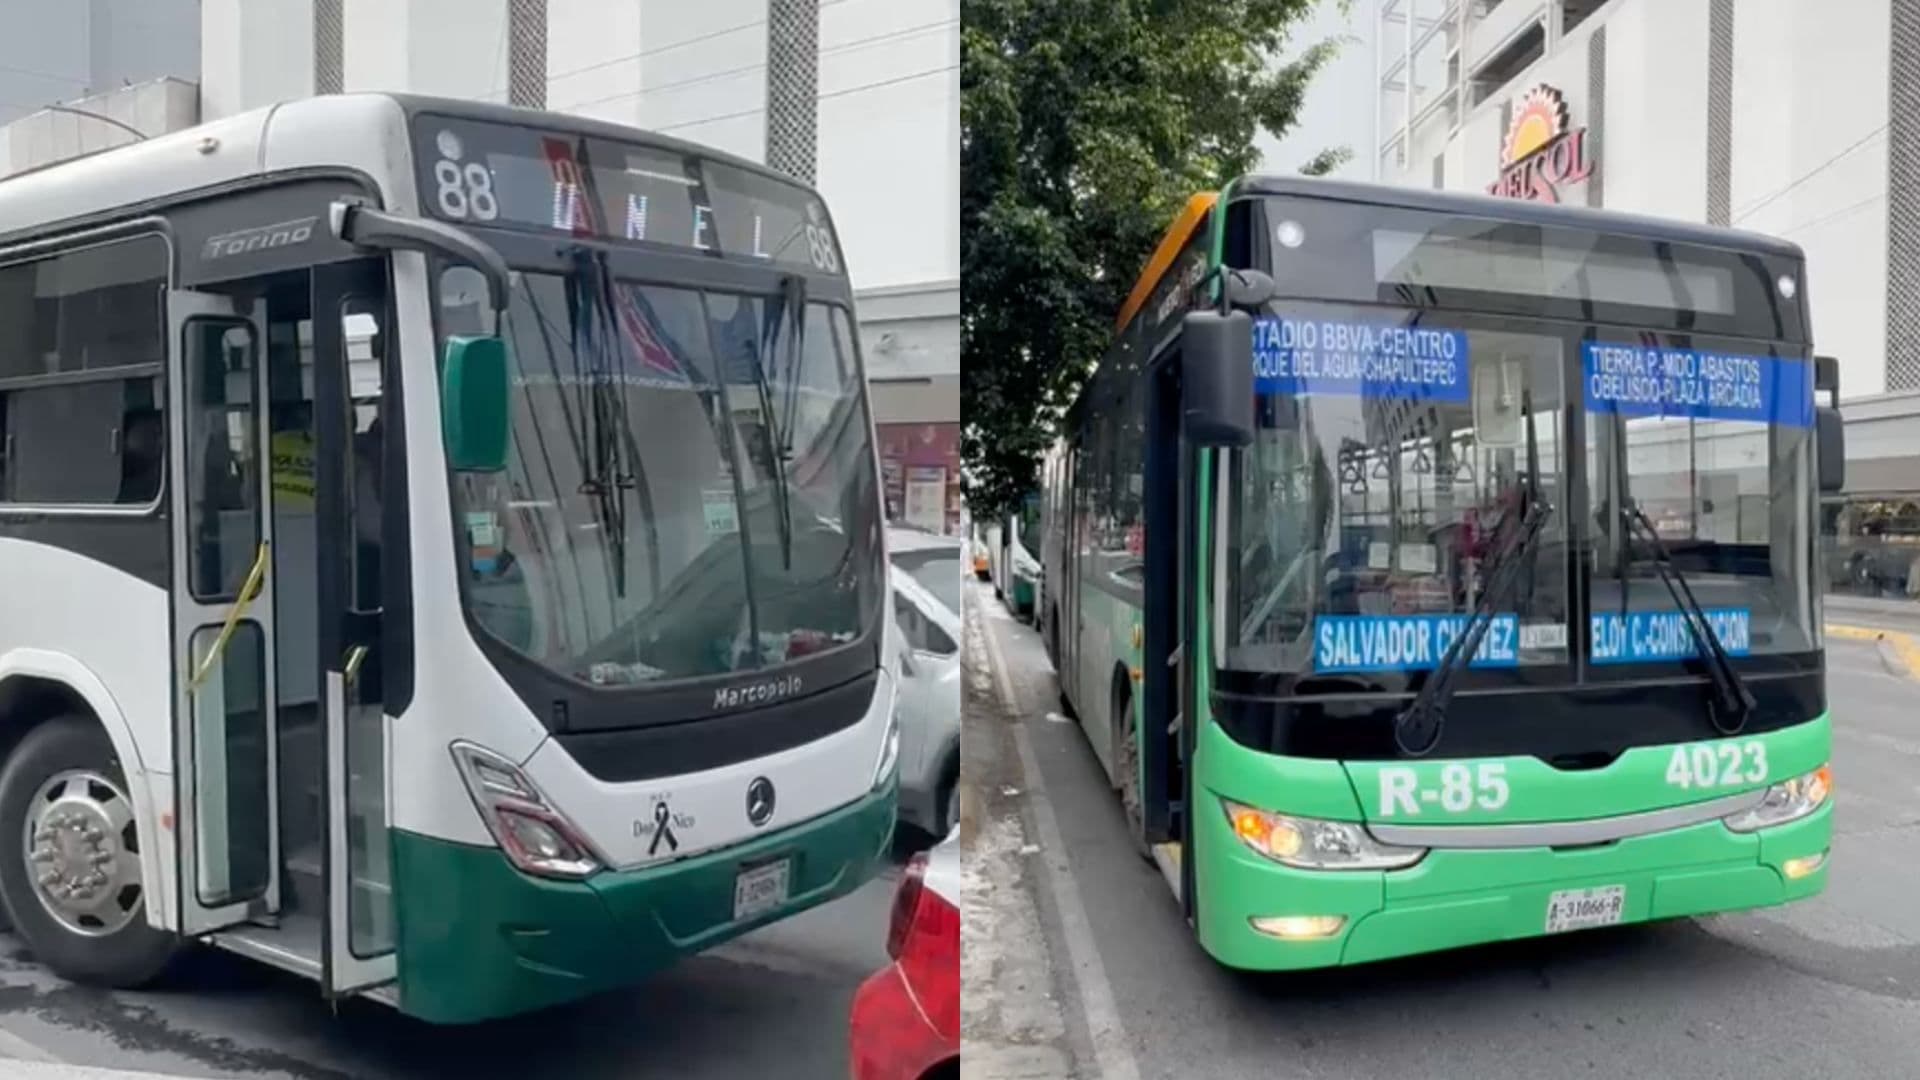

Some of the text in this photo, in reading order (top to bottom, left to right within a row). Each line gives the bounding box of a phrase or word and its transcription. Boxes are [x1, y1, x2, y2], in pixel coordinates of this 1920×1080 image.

[435, 159, 498, 221] 88
[203, 220, 315, 259] Torino
[806, 223, 837, 273] 88
[1322, 322, 1457, 360] BBVA-CENTRO
[1292, 352, 1319, 377] DEL
[1322, 353, 1457, 385] AGUA-CHAPULTEPEC
[1590, 345, 1644, 375] TIERRA
[1698, 354, 1760, 385] ABASTOS
[1591, 373, 1762, 409] OBELISCO-PLAZA ARCADIA
[1319, 619, 1431, 667] SALVADOR
[1591, 614, 1629, 658] ELOY
[712, 674, 802, 710] Marcopolo
[1665, 740, 1769, 789] 4023
[1378, 762, 1509, 817] R-85
